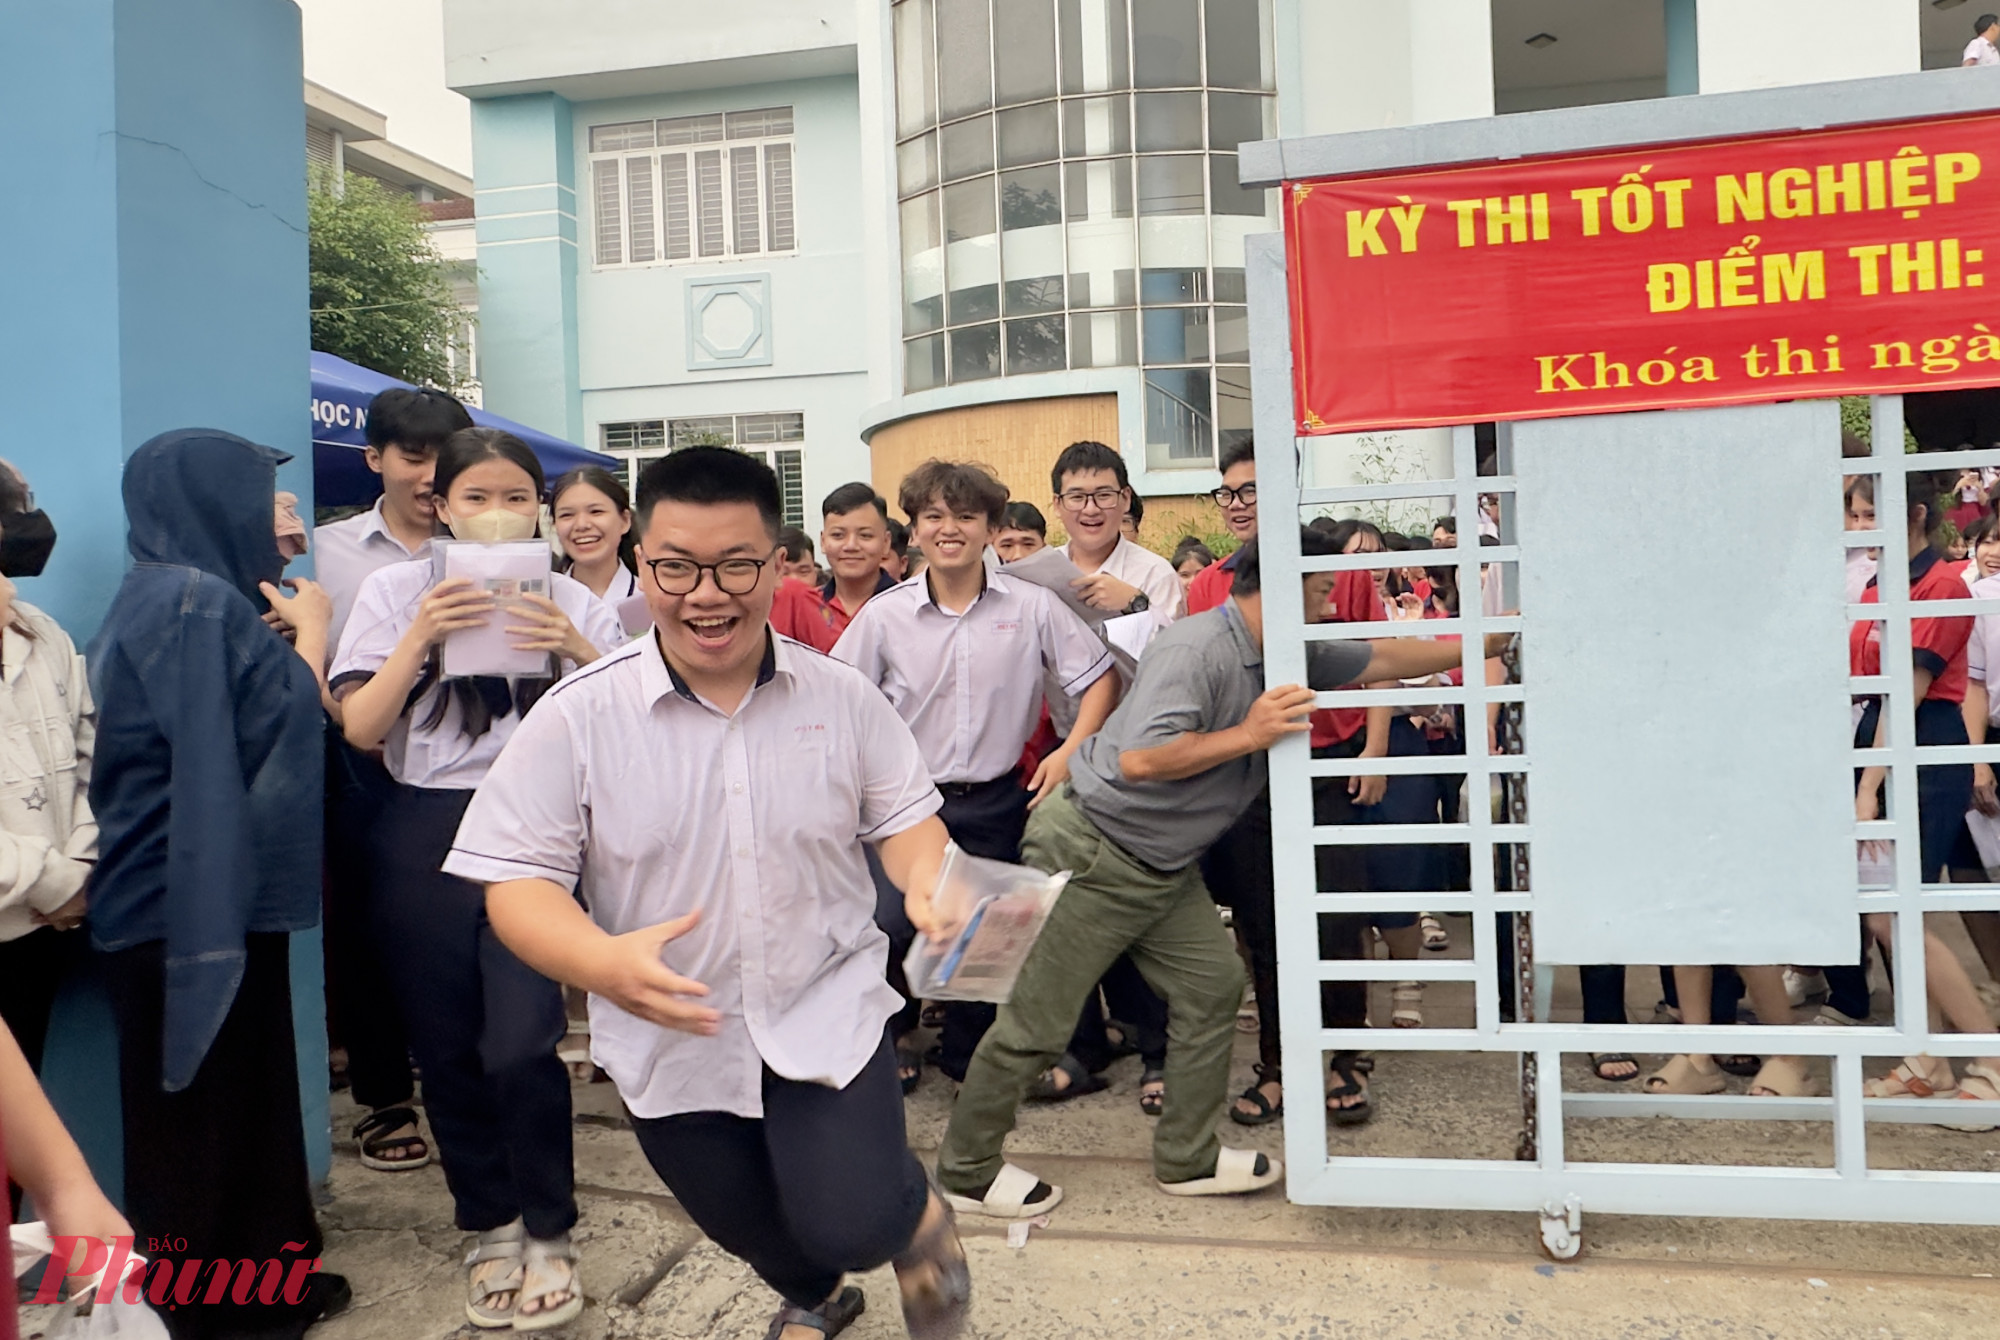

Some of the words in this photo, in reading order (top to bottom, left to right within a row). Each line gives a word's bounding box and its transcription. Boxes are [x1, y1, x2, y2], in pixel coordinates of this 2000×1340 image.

[1345, 194, 1427, 258] KỲ
[1446, 192, 1550, 248] THI
[1571, 164, 1693, 236] TỐT
[1715, 145, 1982, 225] NGHIỆP
[1645, 233, 1826, 313] ĐIỂM
[1848, 238, 1984, 297] THI:
[1533, 345, 1720, 393] Khóa
[1740, 334, 1845, 379] thi
